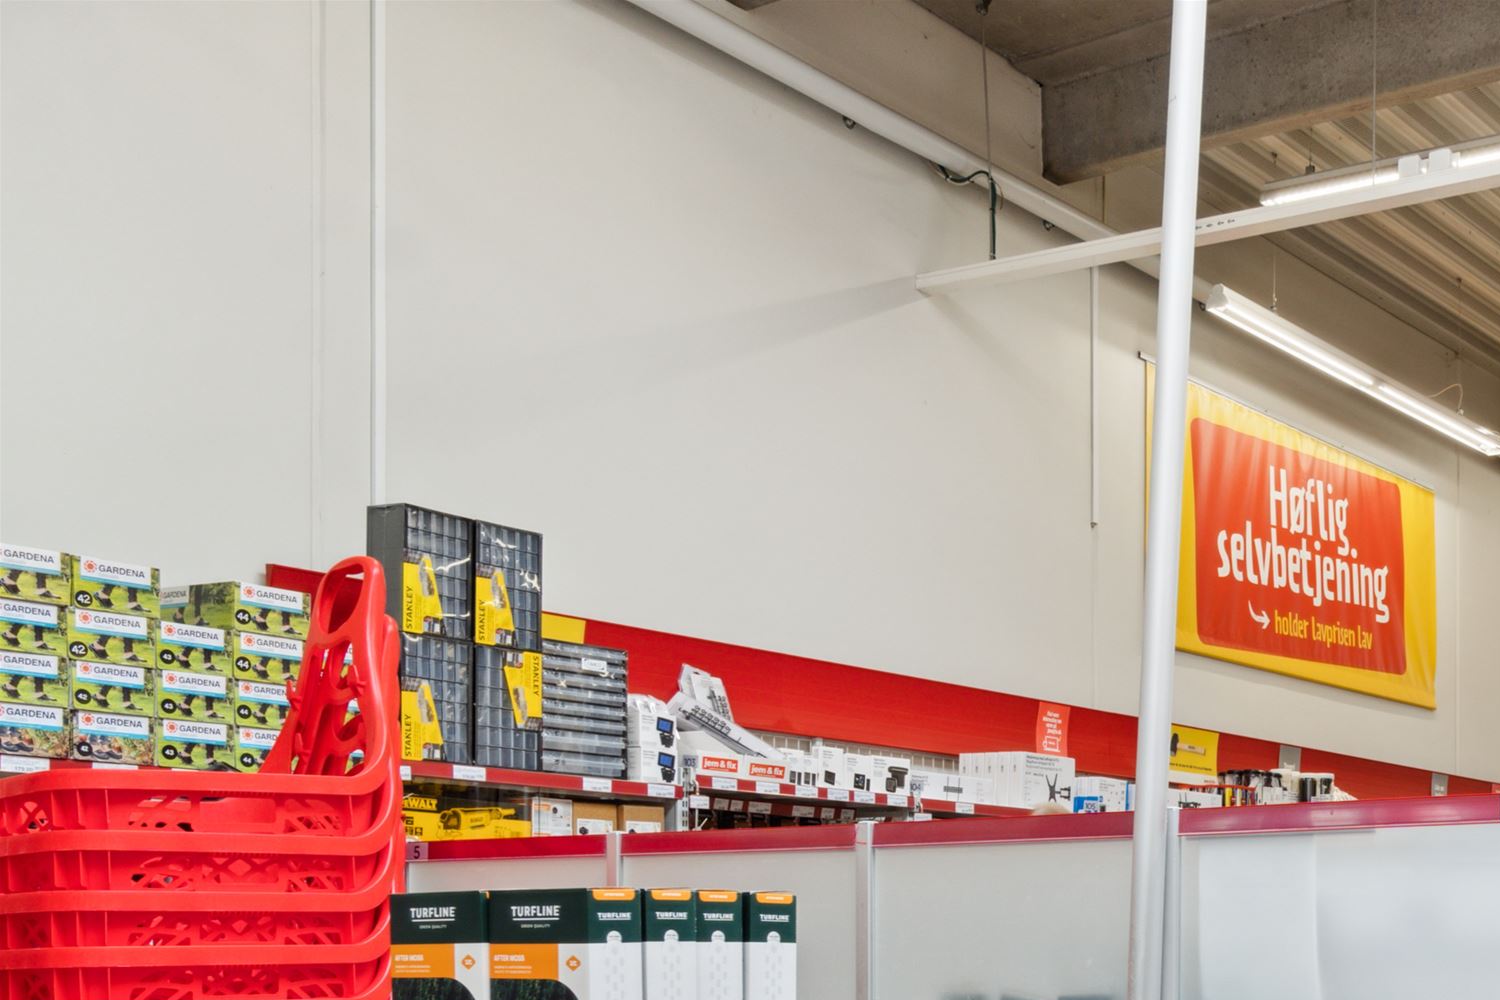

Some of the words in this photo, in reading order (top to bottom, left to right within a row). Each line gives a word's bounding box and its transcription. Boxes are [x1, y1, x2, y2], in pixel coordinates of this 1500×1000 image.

[1269, 464, 1349, 557] Høflig
[4, 549, 55, 564] GARDENA
[99, 564, 145, 579] GARDENA
[1217, 520, 1390, 624] selvbetjening
[77, 594, 91, 604] 42
[256, 590, 298, 604] GARDENA
[3, 603, 51, 617] GARDENA
[93, 616, 141, 629] GARDENA
[237, 613, 249, 622] 44
[478, 599, 486, 641] STANLEY
[177, 629, 219, 641] GARDENA
[1275, 609, 1309, 639] holder
[1311, 617, 1355, 650] lavprisen
[1358, 625, 1373, 650] lav
[71, 645, 86, 655] 42
[256, 638, 298, 652] GARDENA
[3, 655, 52, 668] GARDENA
[237, 660, 250, 668] 44
[94, 667, 139, 679] GARDENA
[532, 656, 540, 696] STANLEY
[178, 676, 220, 688] GARDENA
[253, 685, 287, 696] GARDEN
[6, 707, 56, 720] GARDENA
[96, 717, 143, 729] GARDENA
[179, 725, 221, 736] GARDENA
[254, 732, 278, 742] GARD
[413, 845, 420, 860] 5
[410, 906, 456, 919] TURFLINE
[511, 905, 560, 918] TURFLINE
[597, 912, 632, 921] TURFLINE
[655, 911, 688, 920] TURFLINE
[703, 913, 734, 921] TURFLINE
[760, 913, 790, 922] TURFLINE
